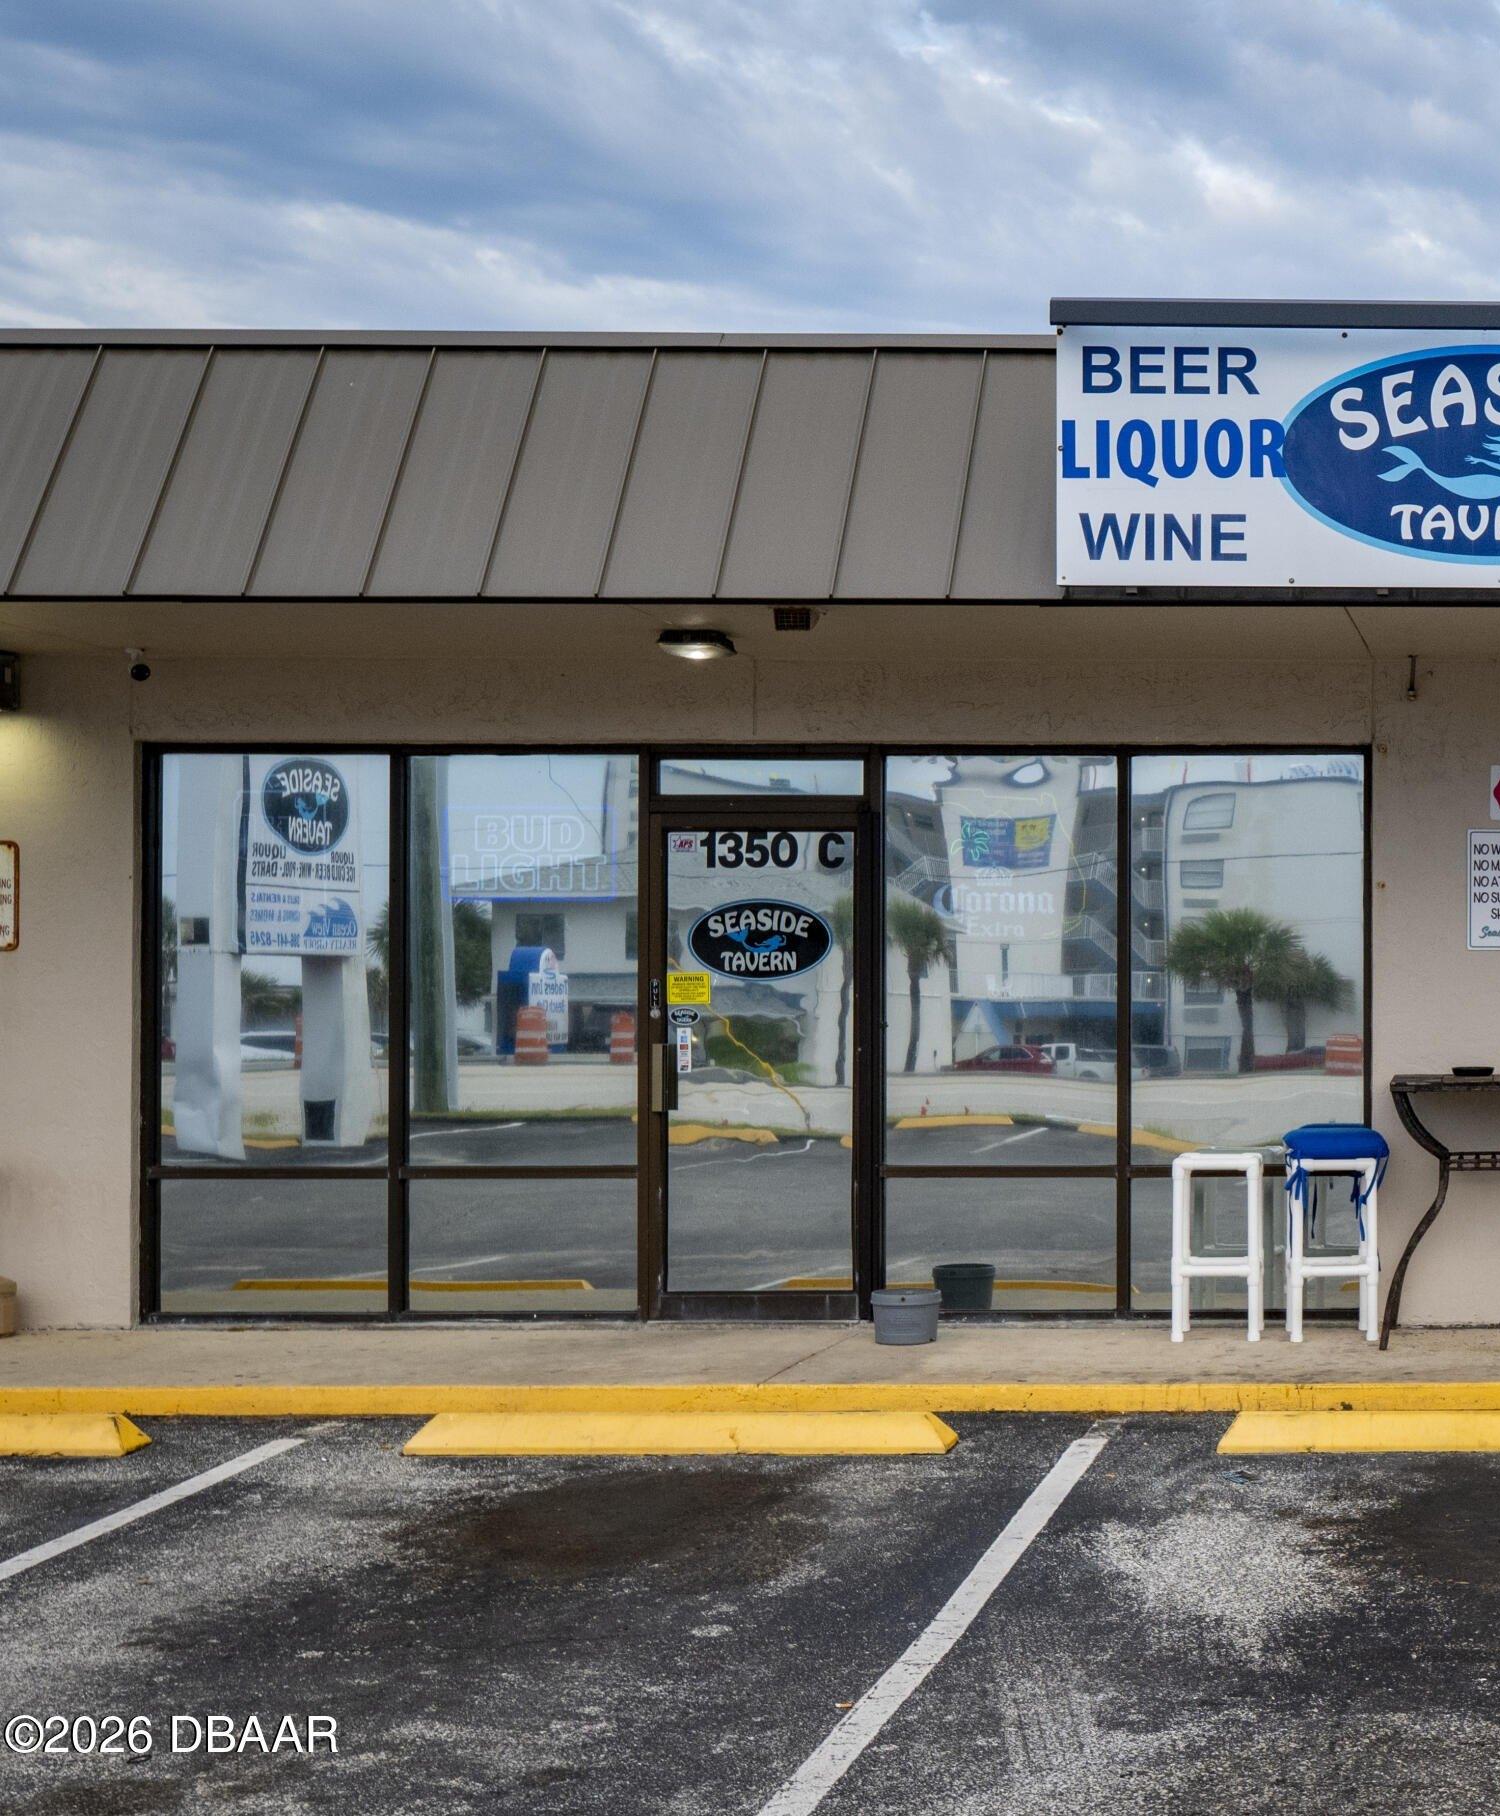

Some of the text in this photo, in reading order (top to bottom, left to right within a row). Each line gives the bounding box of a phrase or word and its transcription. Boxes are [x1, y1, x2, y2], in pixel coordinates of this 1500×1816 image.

[1081, 346, 1259, 394] BEER
[1062, 418, 1288, 488] LIQUOR
[1079, 513, 1249, 562] WINE
[475, 815, 585, 853] BUD
[700, 831, 846, 869] 1350 C
[1473, 843, 1489, 856] NO
[451, 853, 607, 892] LIGHT
[1473, 860, 1489, 872] NO
[1473, 876, 1489, 888] NO
[933, 883, 1055, 919] Corona
[1473, 892, 1489, 904] NO
[707, 908, 814, 939] SEASIDE
[720, 951, 797, 972] TAVERN
